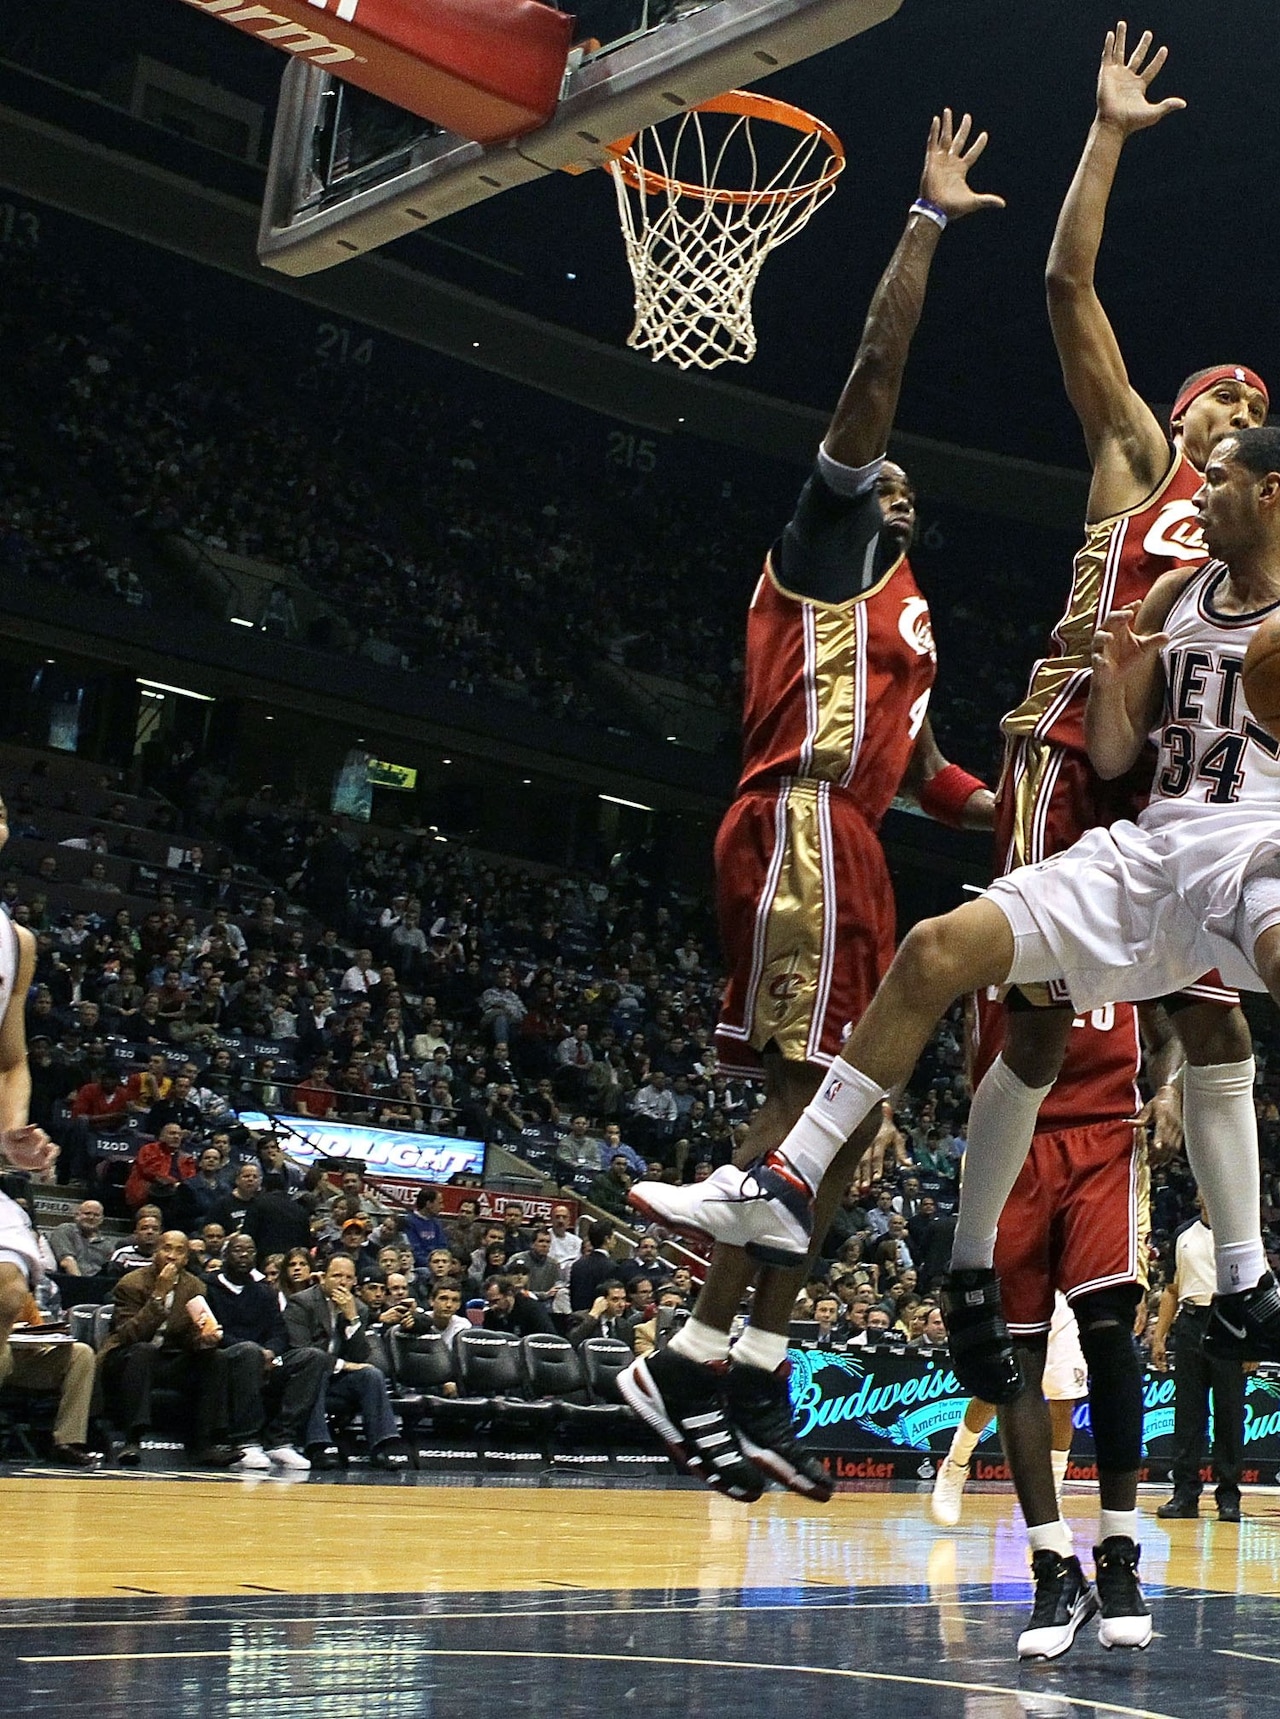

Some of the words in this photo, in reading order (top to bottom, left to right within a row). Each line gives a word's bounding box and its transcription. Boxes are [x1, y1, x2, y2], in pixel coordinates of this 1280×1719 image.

[0, 203, 40, 248] 13
[315, 322, 374, 366] 214
[1158, 723, 1250, 804] 34
[1072, 1001, 1115, 1031] 0
[97, 1140, 129, 1151] IZOD
[795, 1361, 962, 1438] Budweise
[911, 1409, 962, 1437] American
[836, 1456, 895, 1478] Locker
